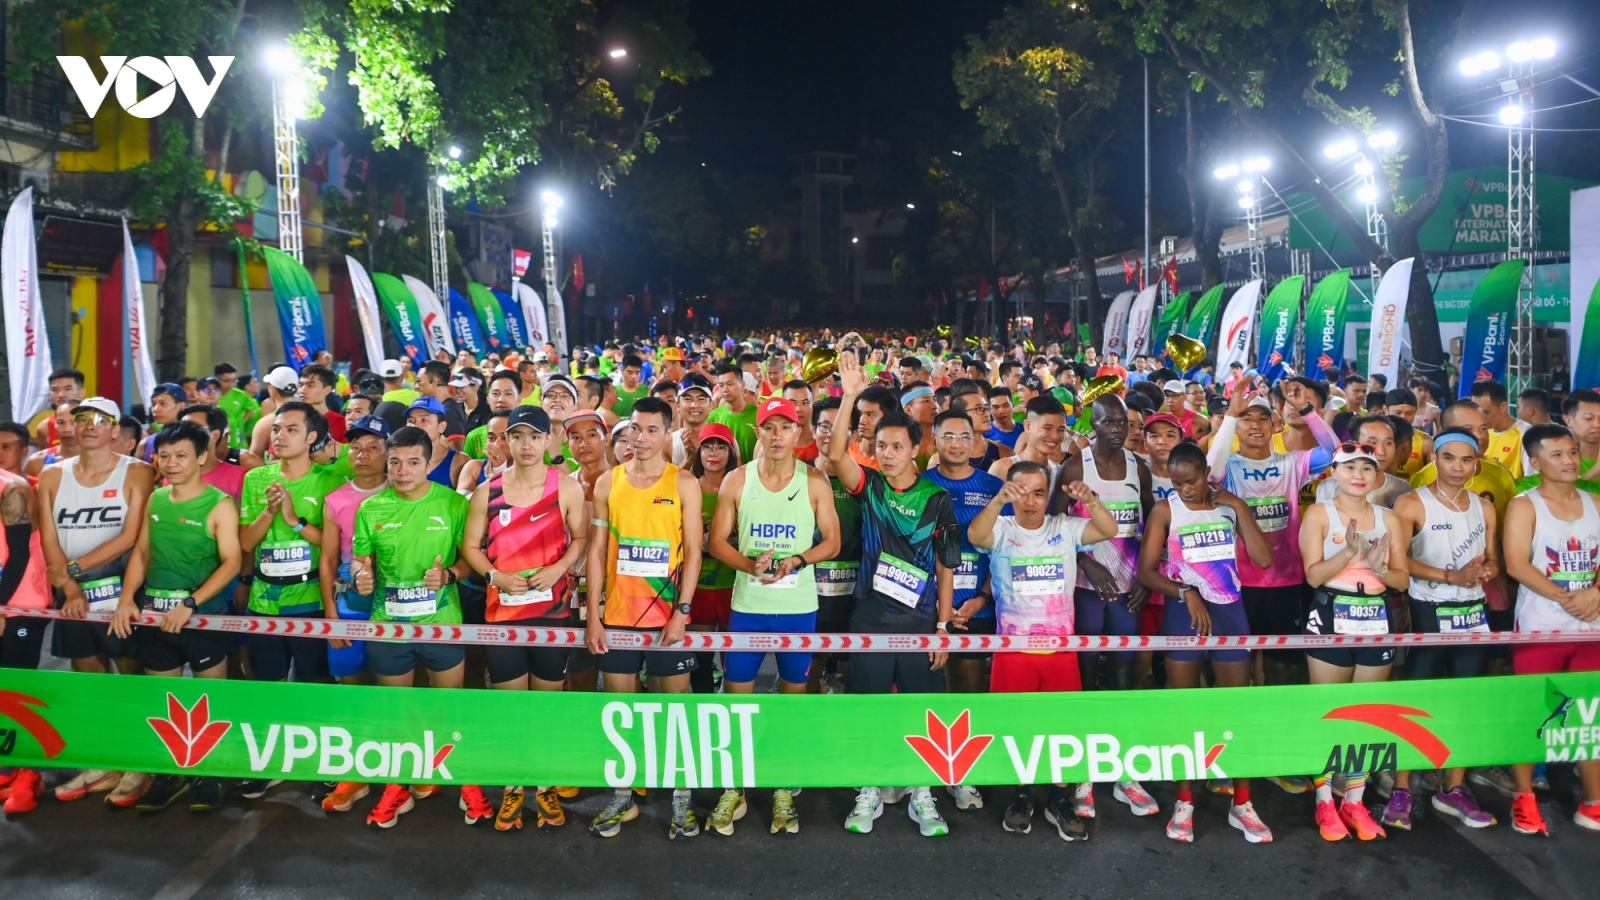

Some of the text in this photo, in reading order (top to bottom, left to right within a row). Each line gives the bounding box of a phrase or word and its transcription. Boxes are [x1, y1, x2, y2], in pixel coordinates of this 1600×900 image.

[289, 297, 307, 343] VPBank
[395, 301, 415, 341] VPBank
[484, 304, 498, 335] VPBank
[1322, 304, 1336, 351] VPBank
[1274, 306, 1289, 350] VPBank
[1380, 303, 1396, 367] DIAMOND
[1497, 311, 1508, 346] Securities
[1481, 312, 1499, 365] VPBank
[58, 506, 122, 524] HTC
[1256, 503, 1284, 516] 90311
[750, 523, 796, 539] HBPR
[1431, 521, 1453, 531] cedo
[754, 541, 792, 549] Elite Team
[1194, 530, 1226, 544] 91219
[273, 547, 304, 560] 90160
[632, 546, 663, 560] 91027
[1562, 551, 1588, 561] ELITE
[829, 569, 856, 580] 90694
[1026, 564, 1058, 577] 90022
[1563, 561, 1591, 572] TEAM
[888, 565, 920, 590] 99025
[397, 586, 429, 600] 90830
[1350, 605, 1379, 617] 90357
[1453, 612, 1481, 626] 91402
[685, 658, 695, 667] T8
[240, 723, 455, 780] VPBank
[601, 701, 760, 788] START
[1002, 731, 1229, 784] VPBank
[1321, 742, 1397, 774] ANTA
